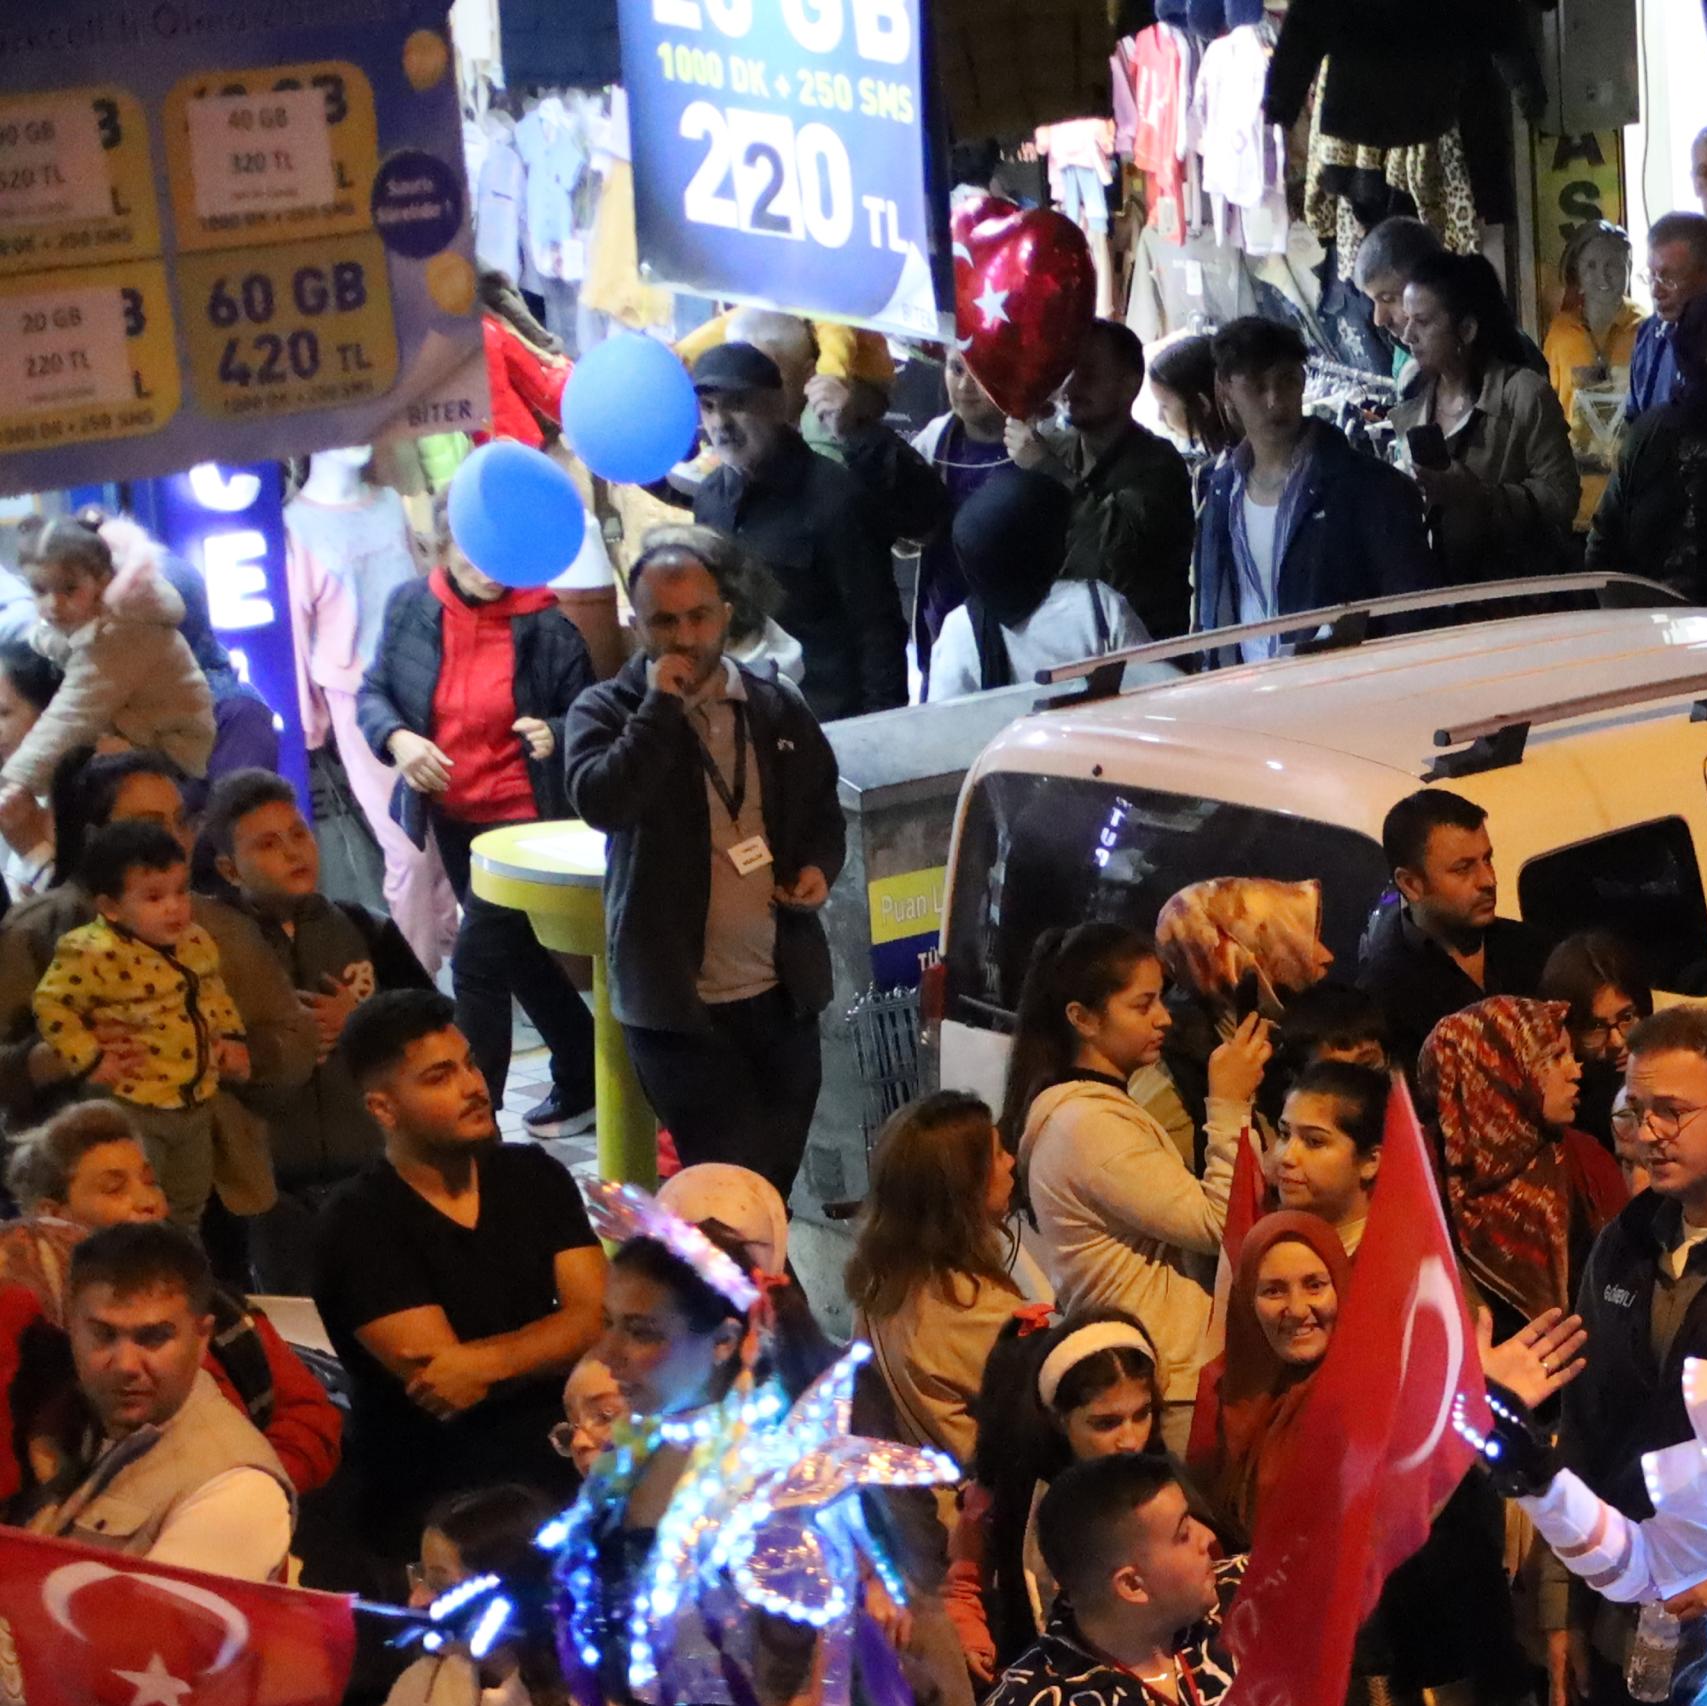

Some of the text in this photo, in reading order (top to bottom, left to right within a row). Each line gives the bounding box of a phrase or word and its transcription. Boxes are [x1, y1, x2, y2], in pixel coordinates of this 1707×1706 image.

[656, 41, 915, 125] 1000 DK + 250 SMS
[680, 100, 910, 254] 220 TL
[53, 305, 82, 329] GB
[207, 274, 275, 329] 60
[292, 260, 367, 317] GB
[218, 329, 373, 387] 420 TL
[879, 894, 927, 924] Puan
